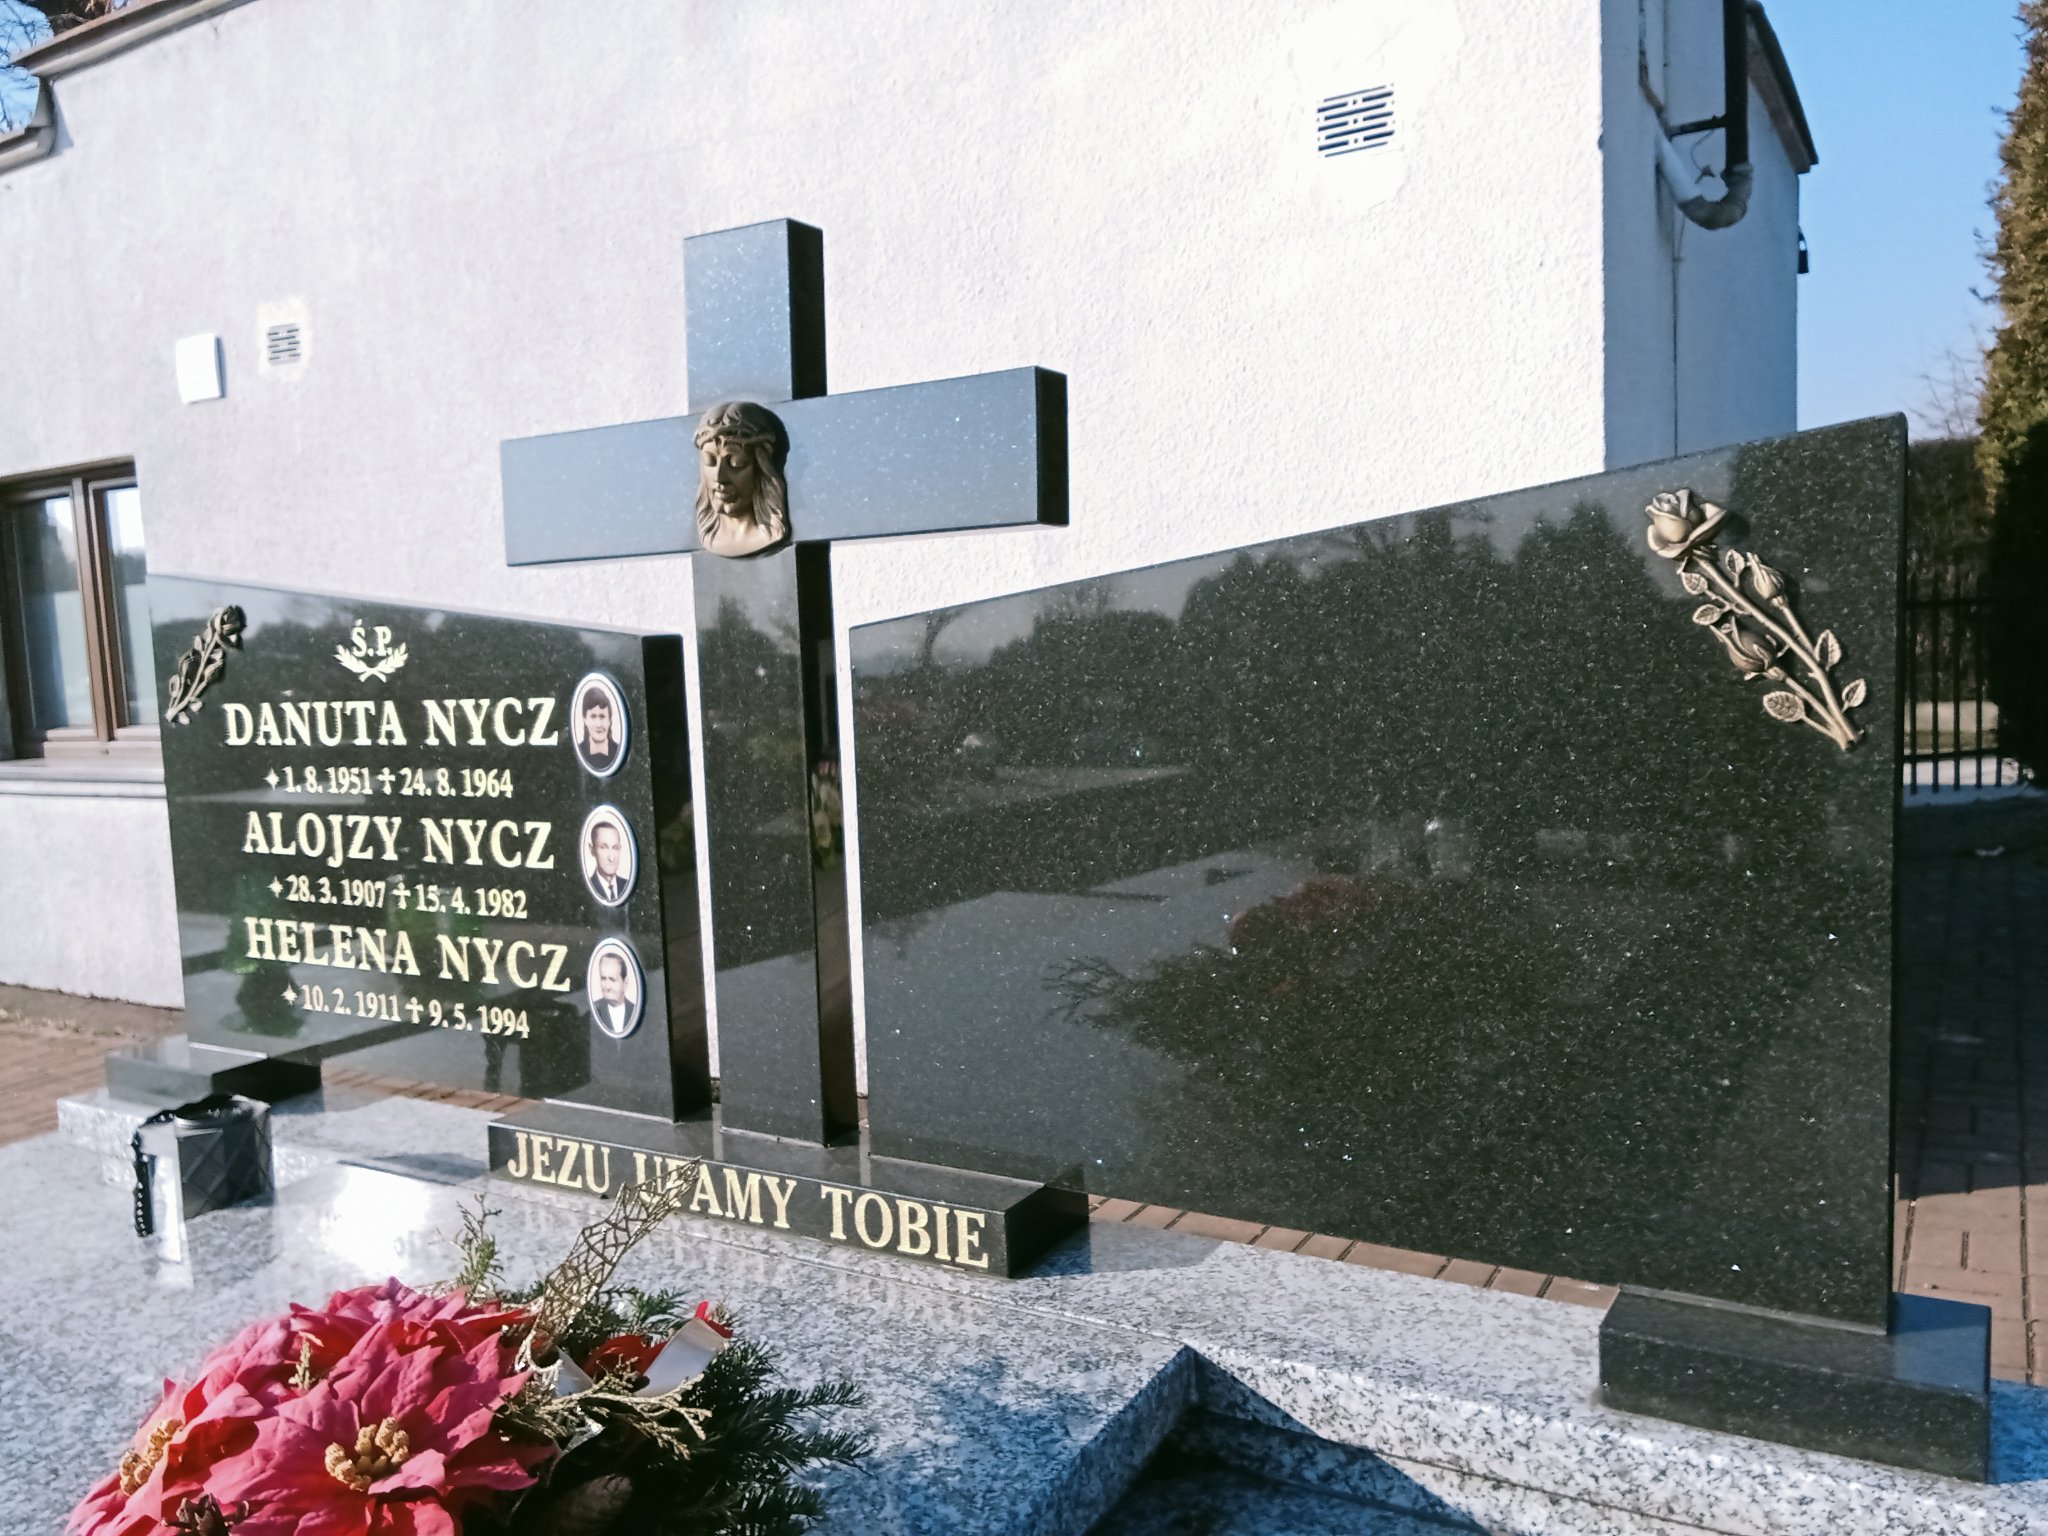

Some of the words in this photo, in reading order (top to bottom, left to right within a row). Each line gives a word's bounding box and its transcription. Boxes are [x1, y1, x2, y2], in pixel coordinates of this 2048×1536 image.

[224, 701, 407, 747] DANUTA
[423, 697, 559, 747] NYCZ
[241, 811, 402, 868] ALOJZY
[420, 817, 555, 869] NYCZ
[244, 916, 421, 976] HELENA
[437, 934, 571, 993] NYCZ
[507, 1132, 611, 1194] JEZU
[821, 1184, 990, 1268] TOBIE
